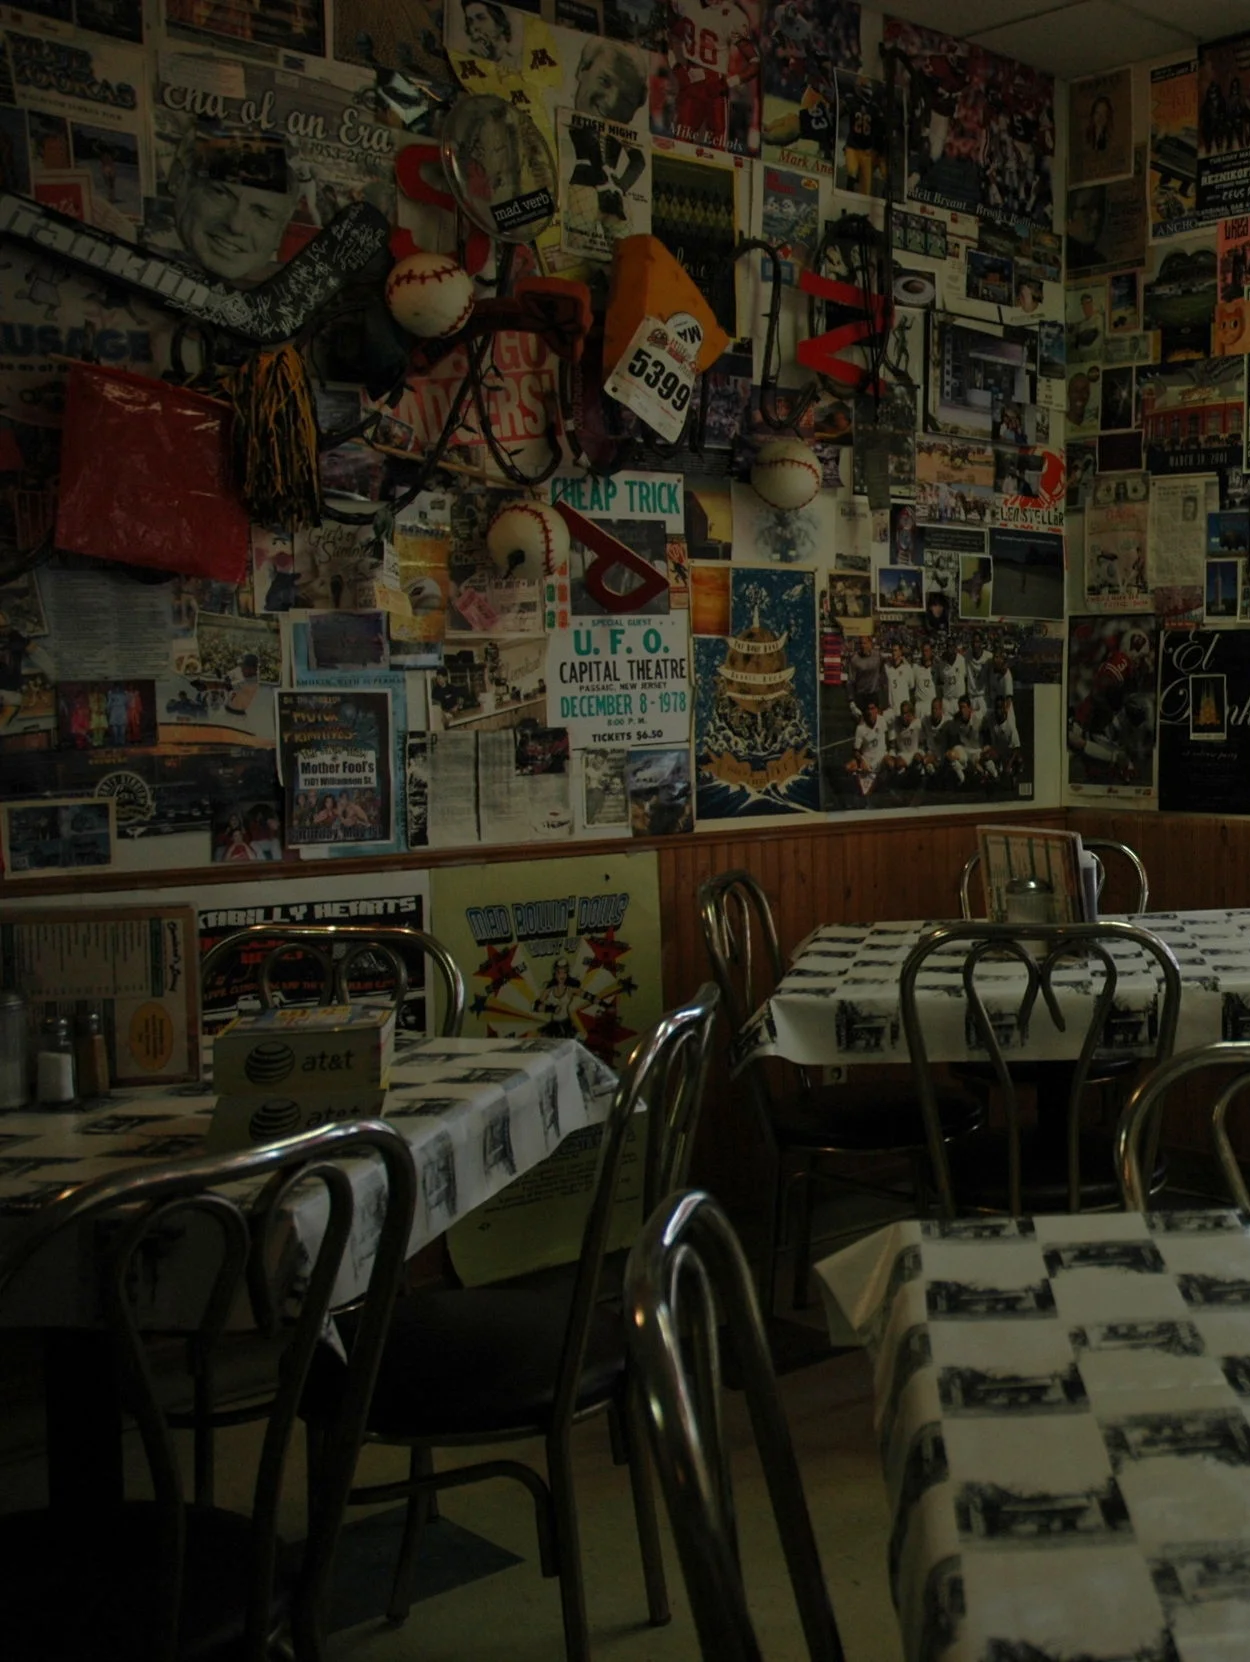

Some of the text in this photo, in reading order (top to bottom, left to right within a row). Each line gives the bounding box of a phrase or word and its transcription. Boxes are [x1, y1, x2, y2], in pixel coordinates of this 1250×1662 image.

[287, 111, 327, 139] an
[338, 108, 393, 152] Era
[571, 114, 639, 141] FETISH NIGHT
[669, 122, 699, 140] Mike
[779, 150, 808, 168] Mark
[494, 204, 522, 221] mad
[524, 192, 550, 208] verb
[628, 347, 691, 411] 5399
[551, 477, 680, 514] CHEAP TRICK
[592, 618, 652, 627] SPECIAL GUEST
[560, 660, 620, 683] CAPITAL
[626, 658, 687, 680] THEATRE
[620, 682, 637, 690] NEW
[641, 681, 667, 690] JERSEY
[560, 694, 633, 718] DECEMBER
[592, 729, 663, 743] TICKETS $6.50
[301, 760, 374, 775] Mother Fool's
[466, 905, 513, 946] MAD
[577, 892, 630, 935] DOLLS
[302, 1049, 355, 1073] at&t
